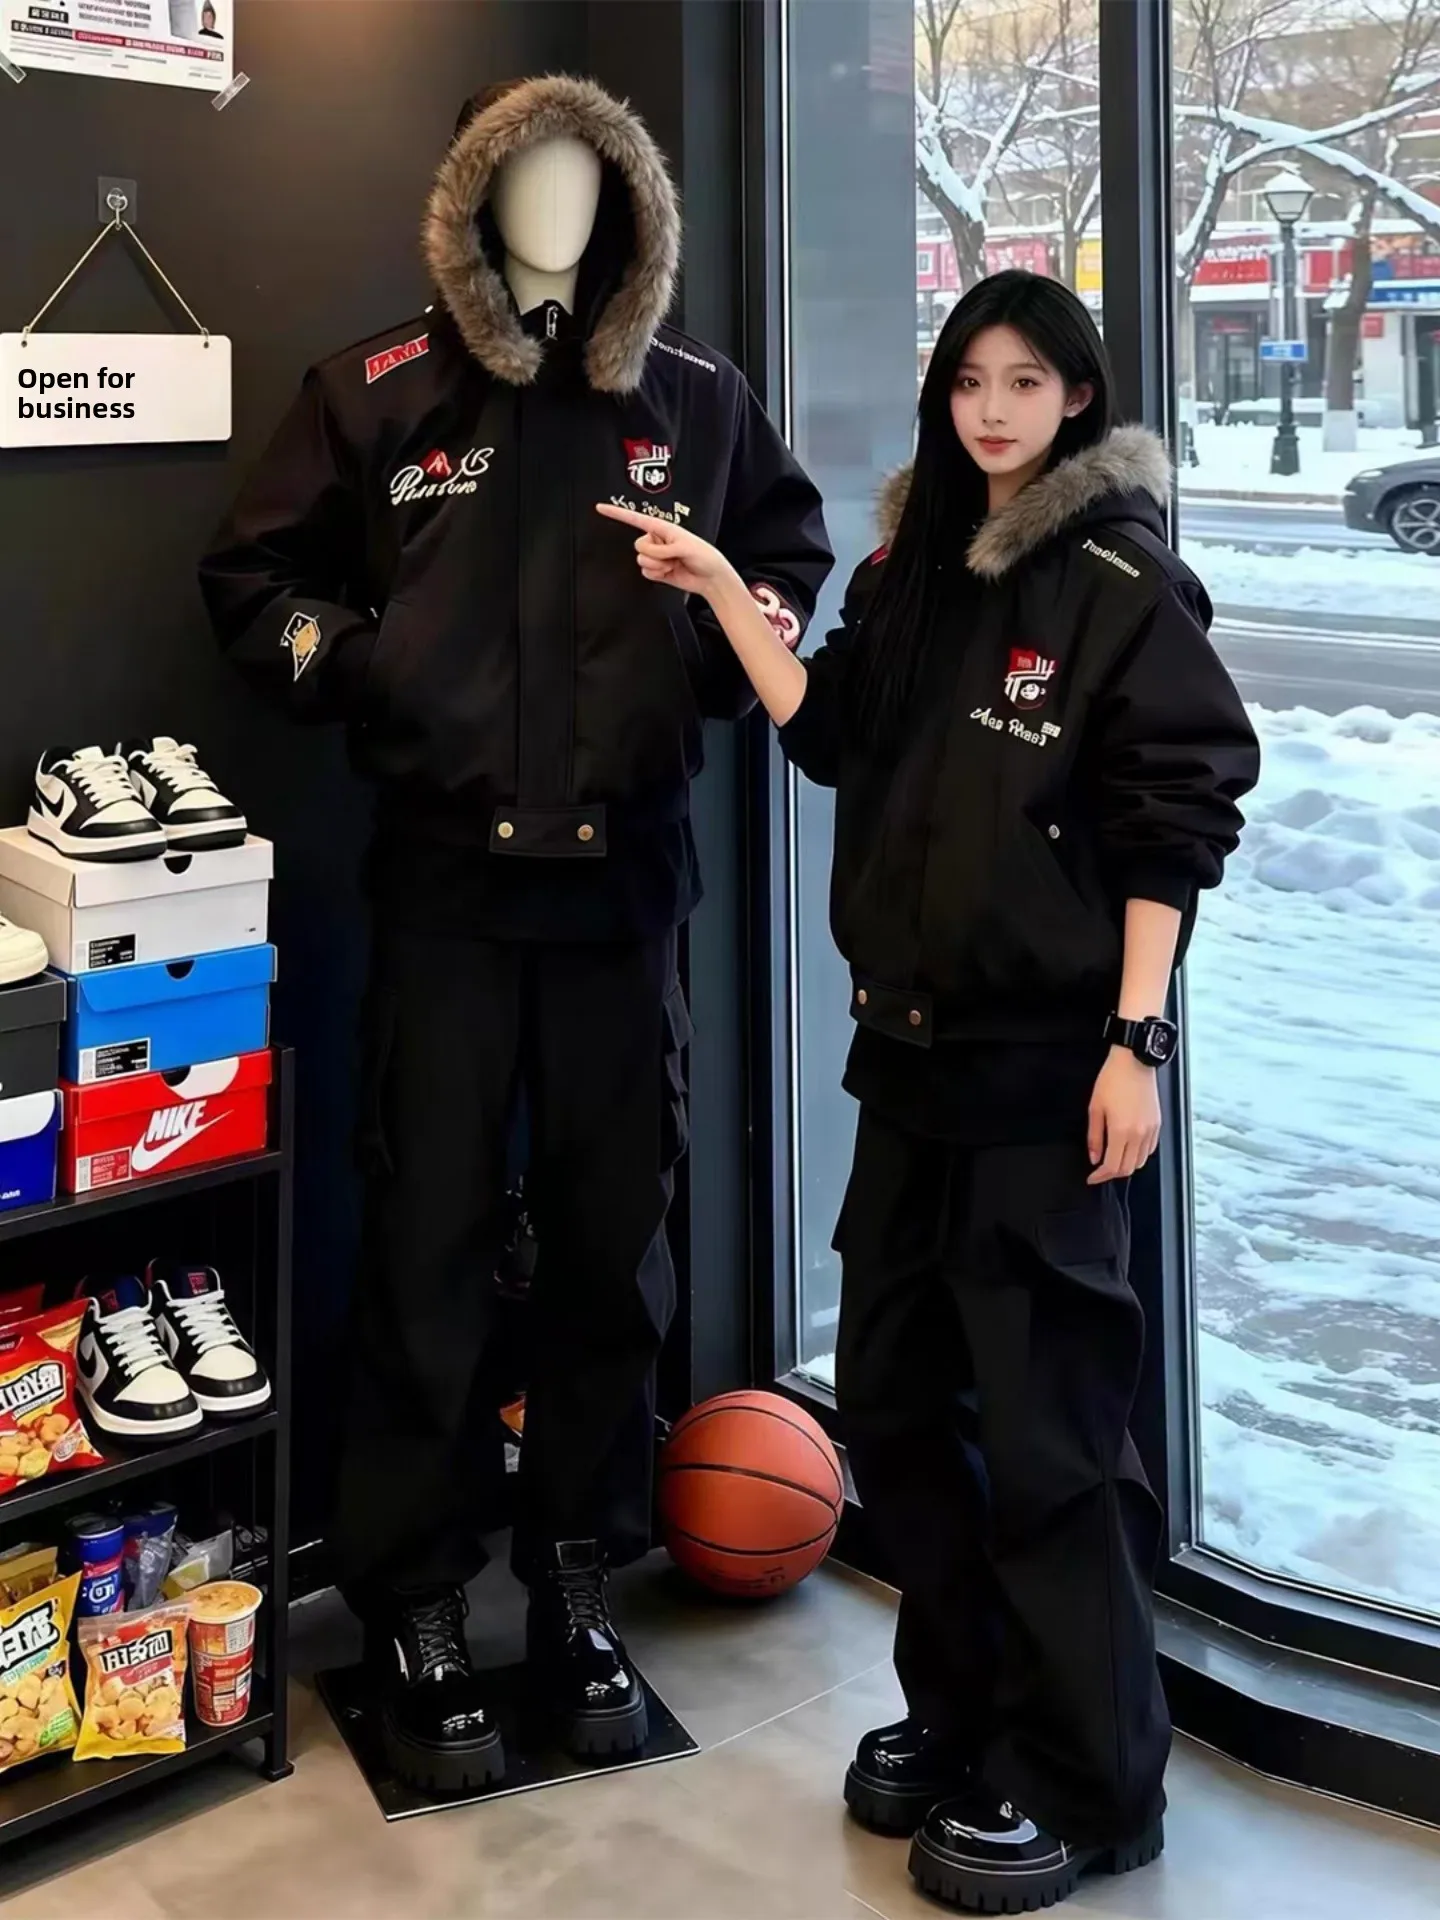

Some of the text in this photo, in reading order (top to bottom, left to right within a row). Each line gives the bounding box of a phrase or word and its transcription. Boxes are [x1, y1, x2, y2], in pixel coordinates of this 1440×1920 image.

[18, 366, 135, 394] Open for
[18, 396, 135, 418] business
[145, 1100, 208, 1143] NIKE
